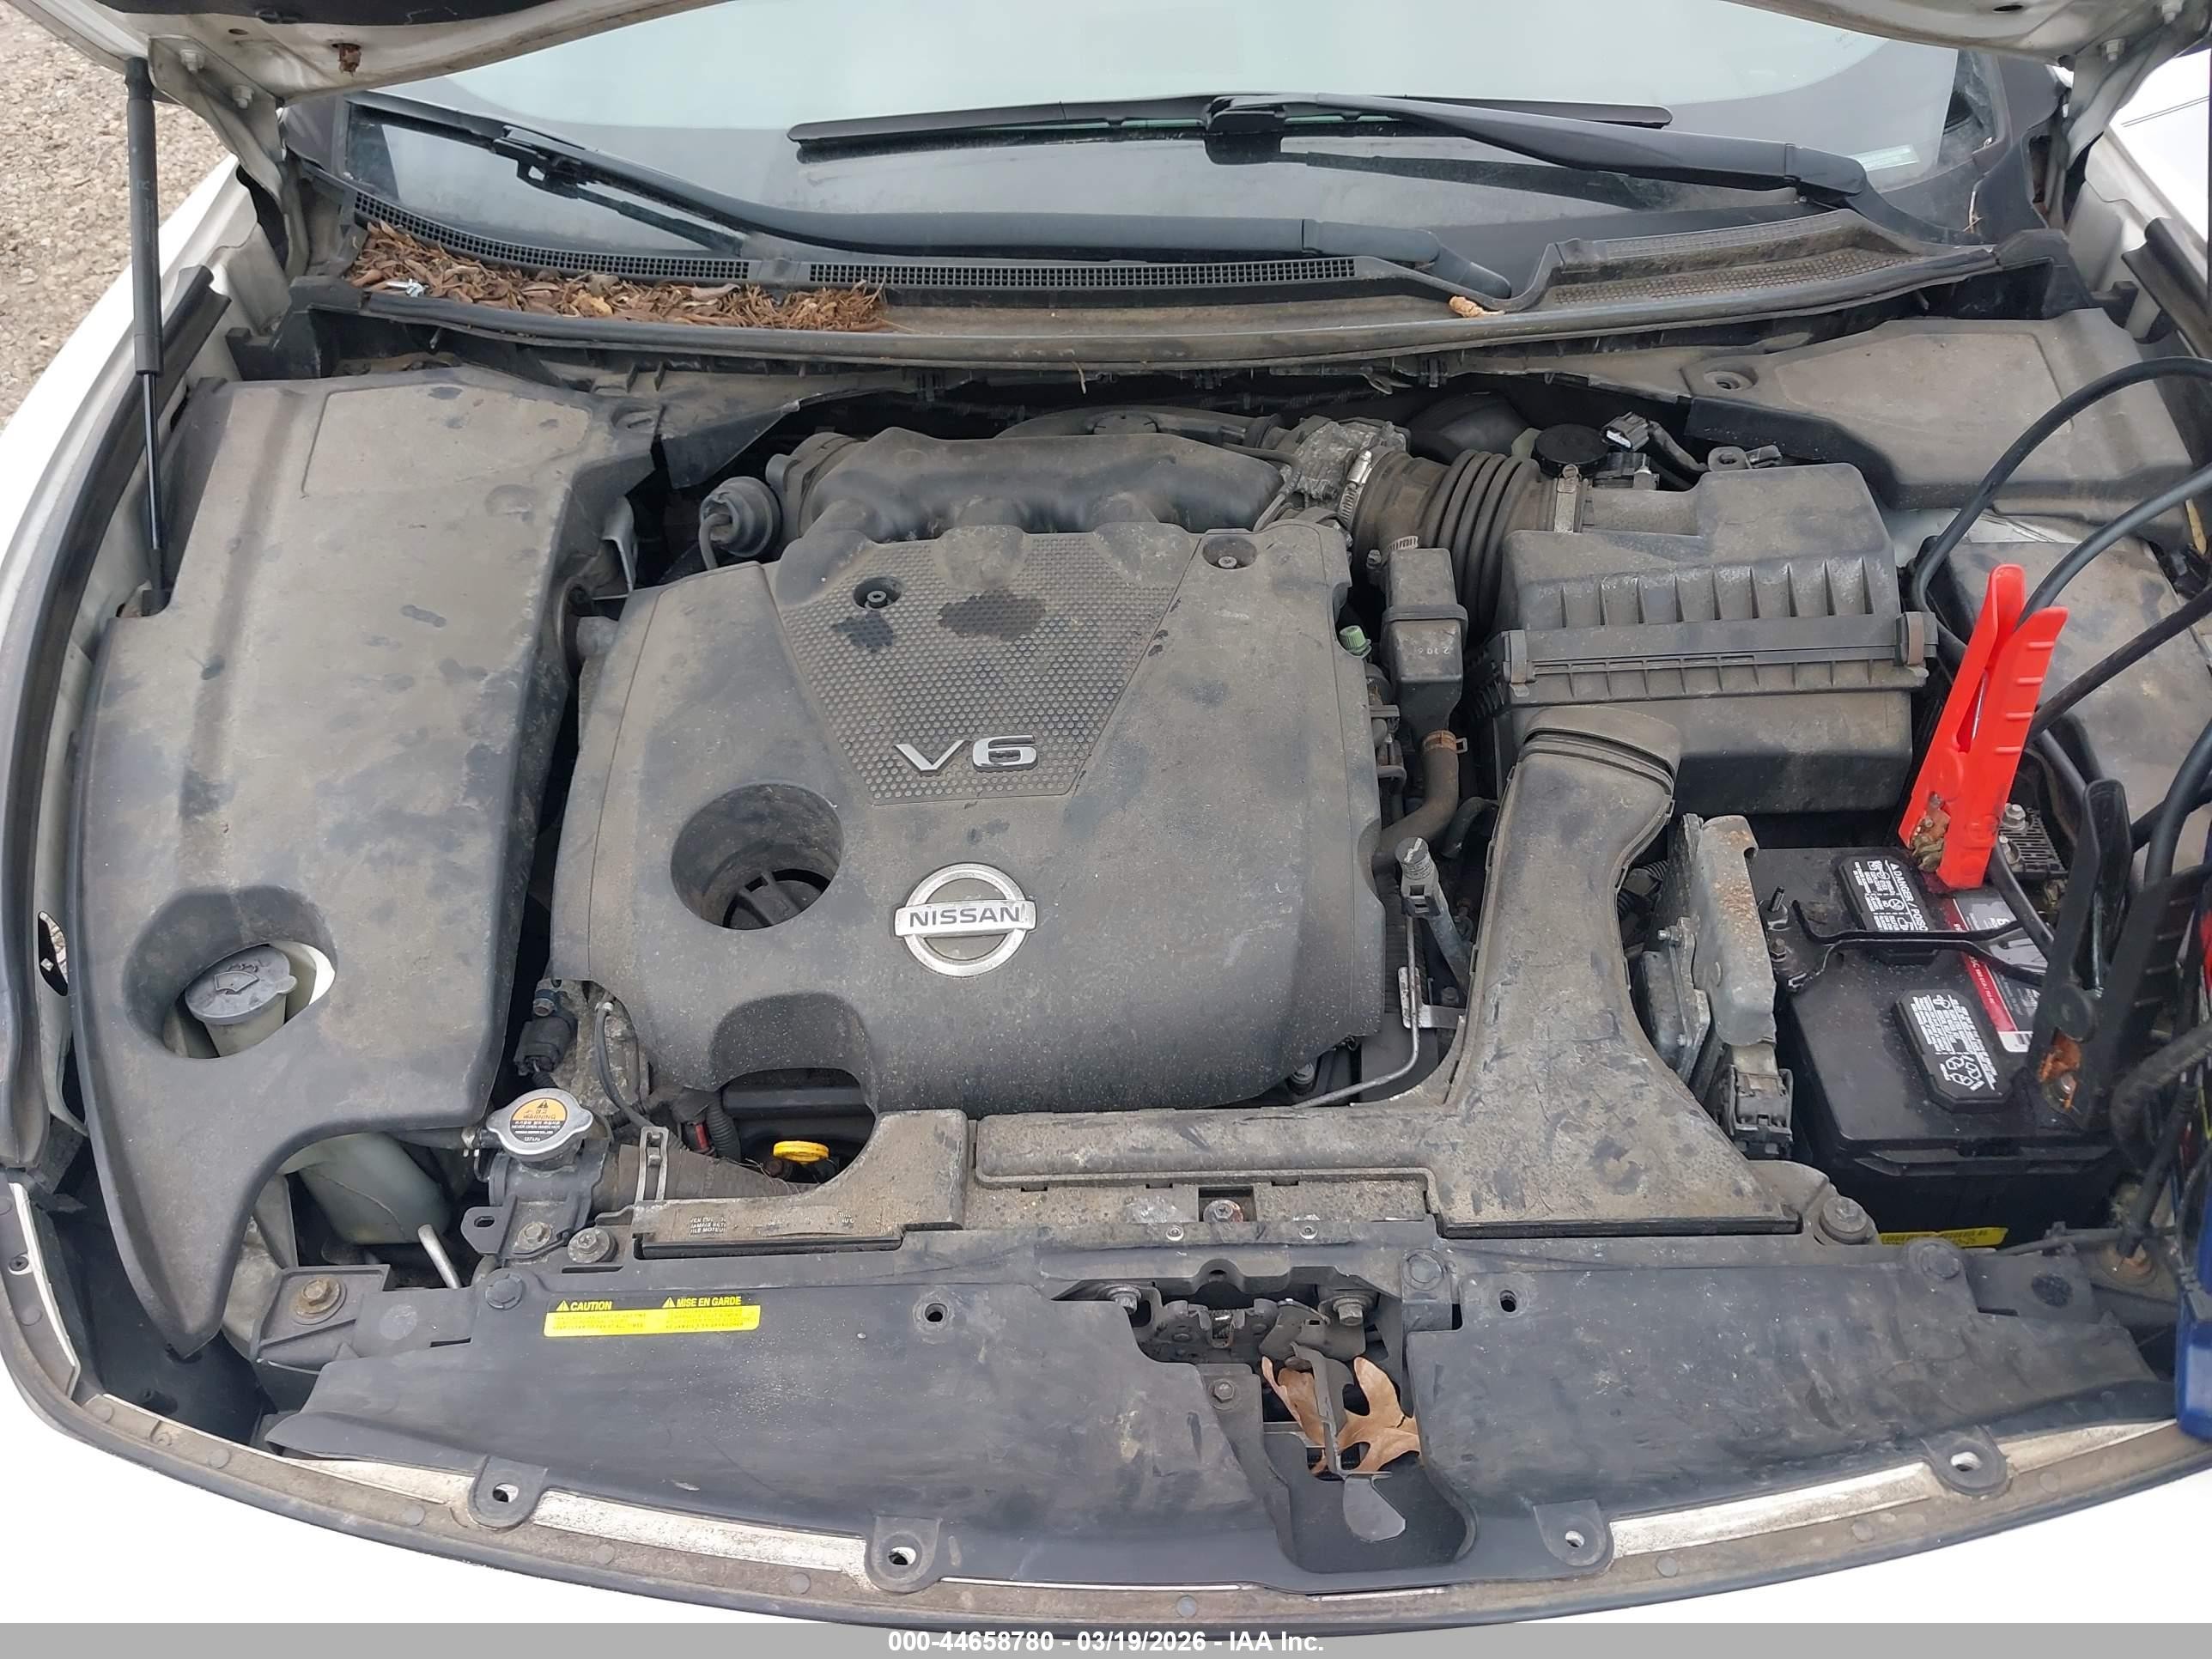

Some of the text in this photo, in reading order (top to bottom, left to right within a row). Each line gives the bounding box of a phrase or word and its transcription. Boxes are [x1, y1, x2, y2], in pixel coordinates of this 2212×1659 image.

[894, 734, 1038, 775] V6
[1893, 871, 1914, 902] DANGER
[1911, 908, 1929, 931] POISO
[909, 906, 1020, 928] NISSAN
[570, 1300, 612, 1311] CAUTION
[676, 1296, 742, 1307] MISE EN GARDE
